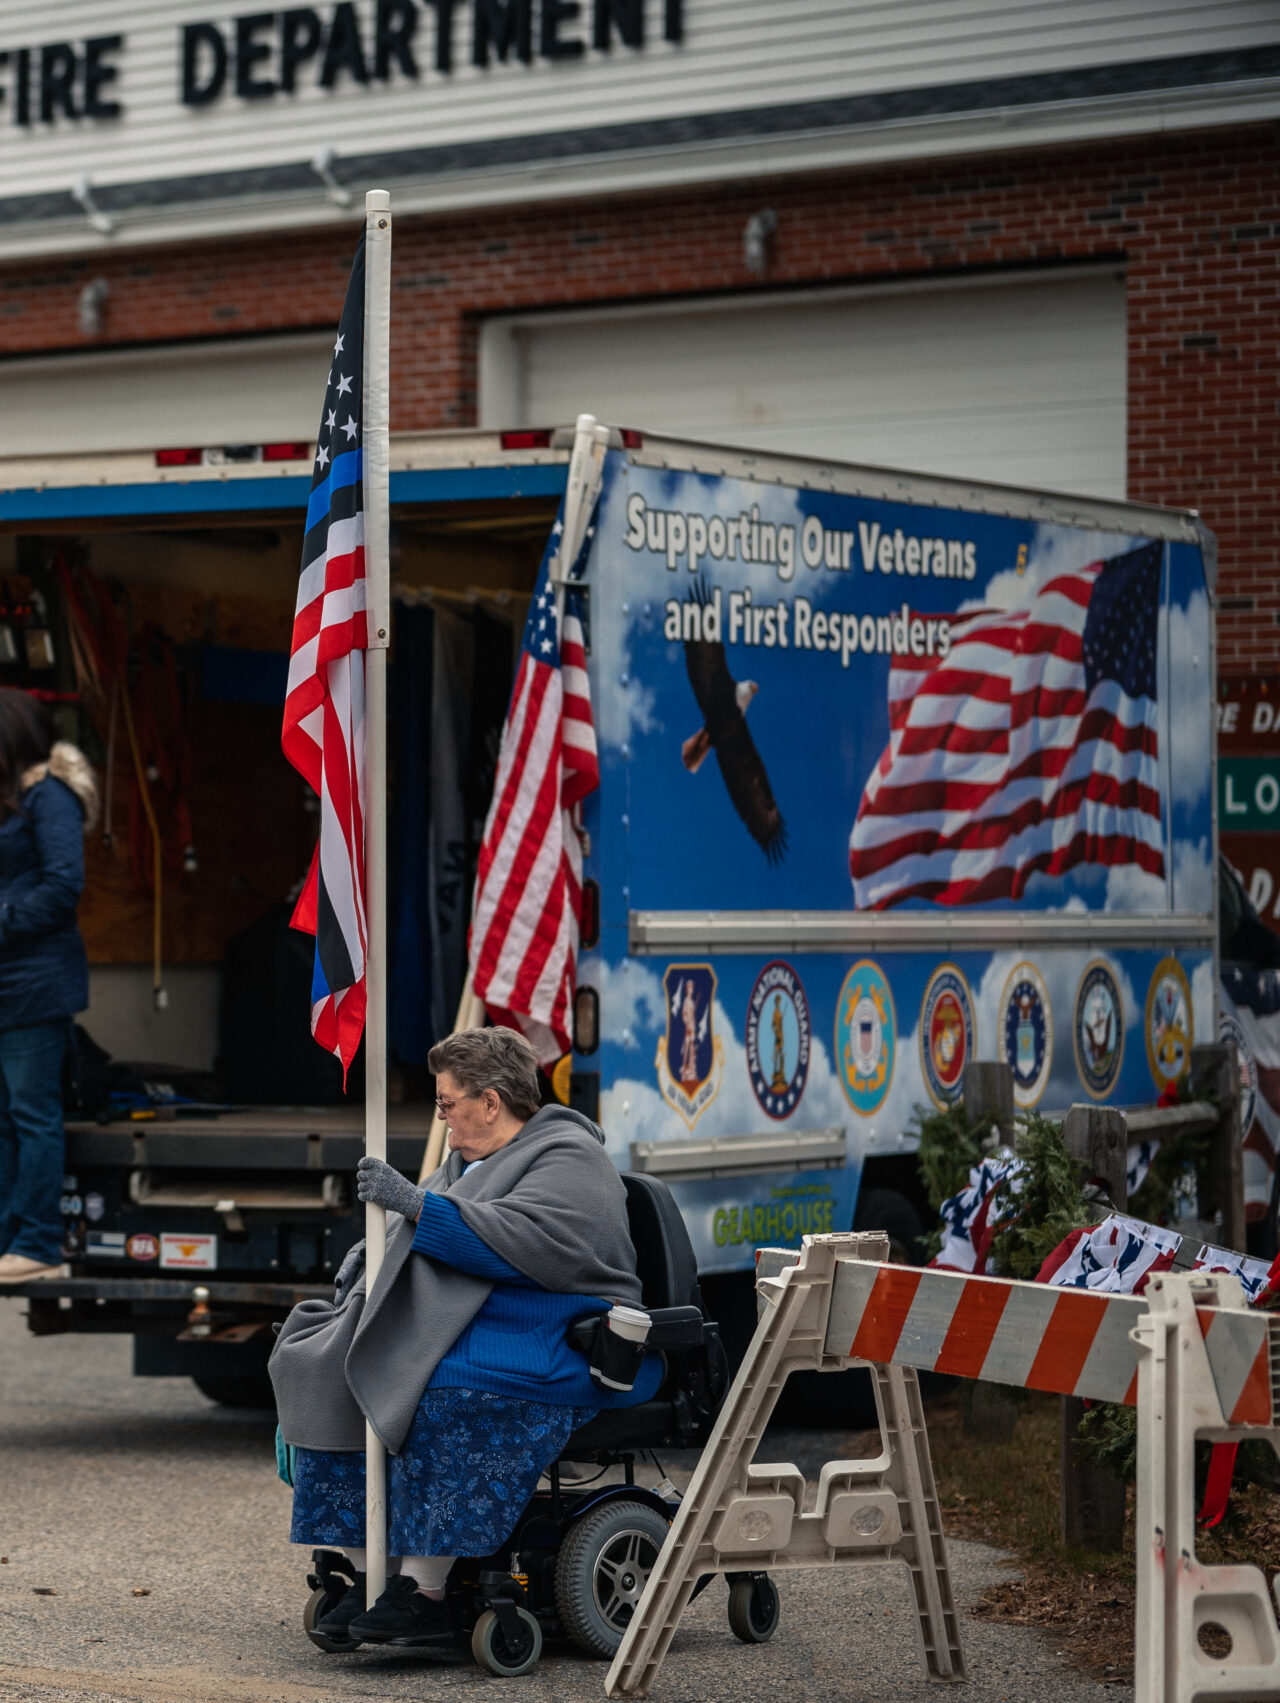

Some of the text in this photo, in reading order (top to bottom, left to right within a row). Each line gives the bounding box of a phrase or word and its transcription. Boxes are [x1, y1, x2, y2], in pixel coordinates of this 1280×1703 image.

[626, 493, 976, 581] Supporting Our Veterans
[665, 586, 950, 668] and First Responders
[1251, 701, 1280, 734] D
[713, 1201, 833, 1247] GEARHOUSE
